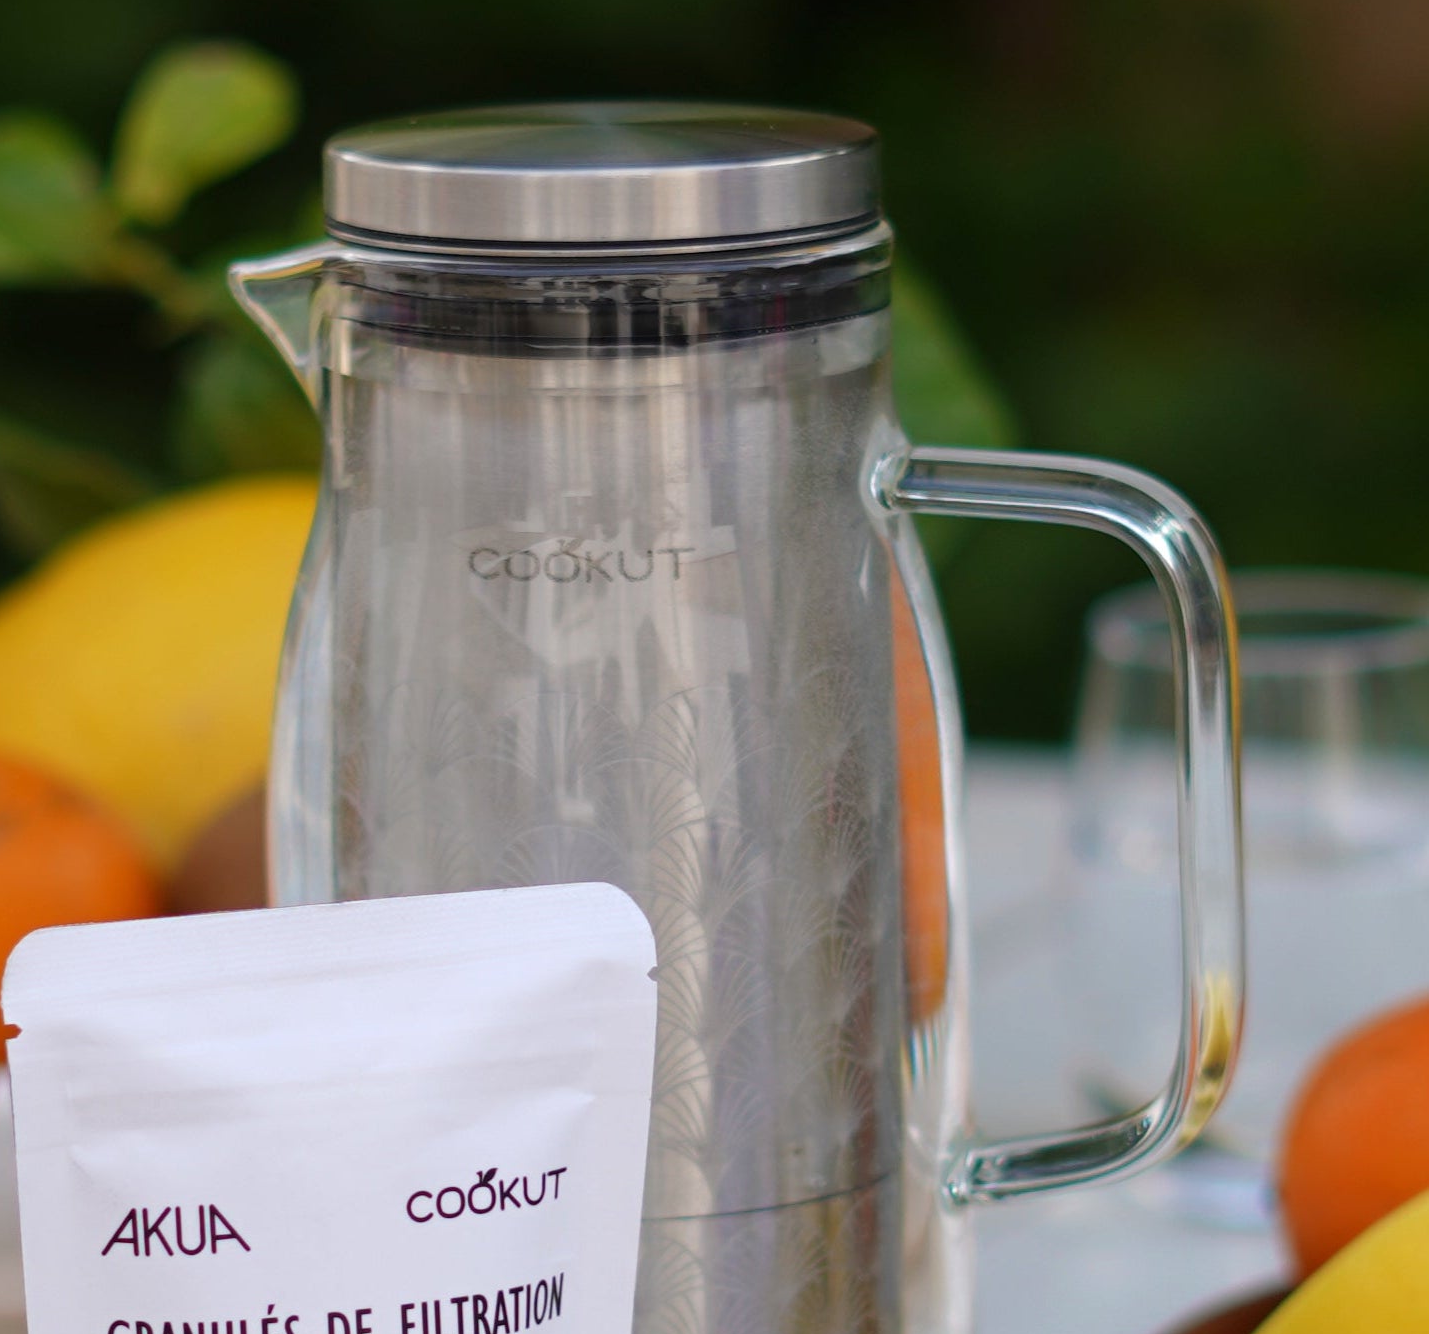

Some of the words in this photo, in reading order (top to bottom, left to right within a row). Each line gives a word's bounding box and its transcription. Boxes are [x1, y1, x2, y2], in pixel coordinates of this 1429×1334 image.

[469, 540, 695, 584] COOKUT
[406, 1167, 567, 1223] COOKUT
[101, 1204, 251, 1257] AKUA
